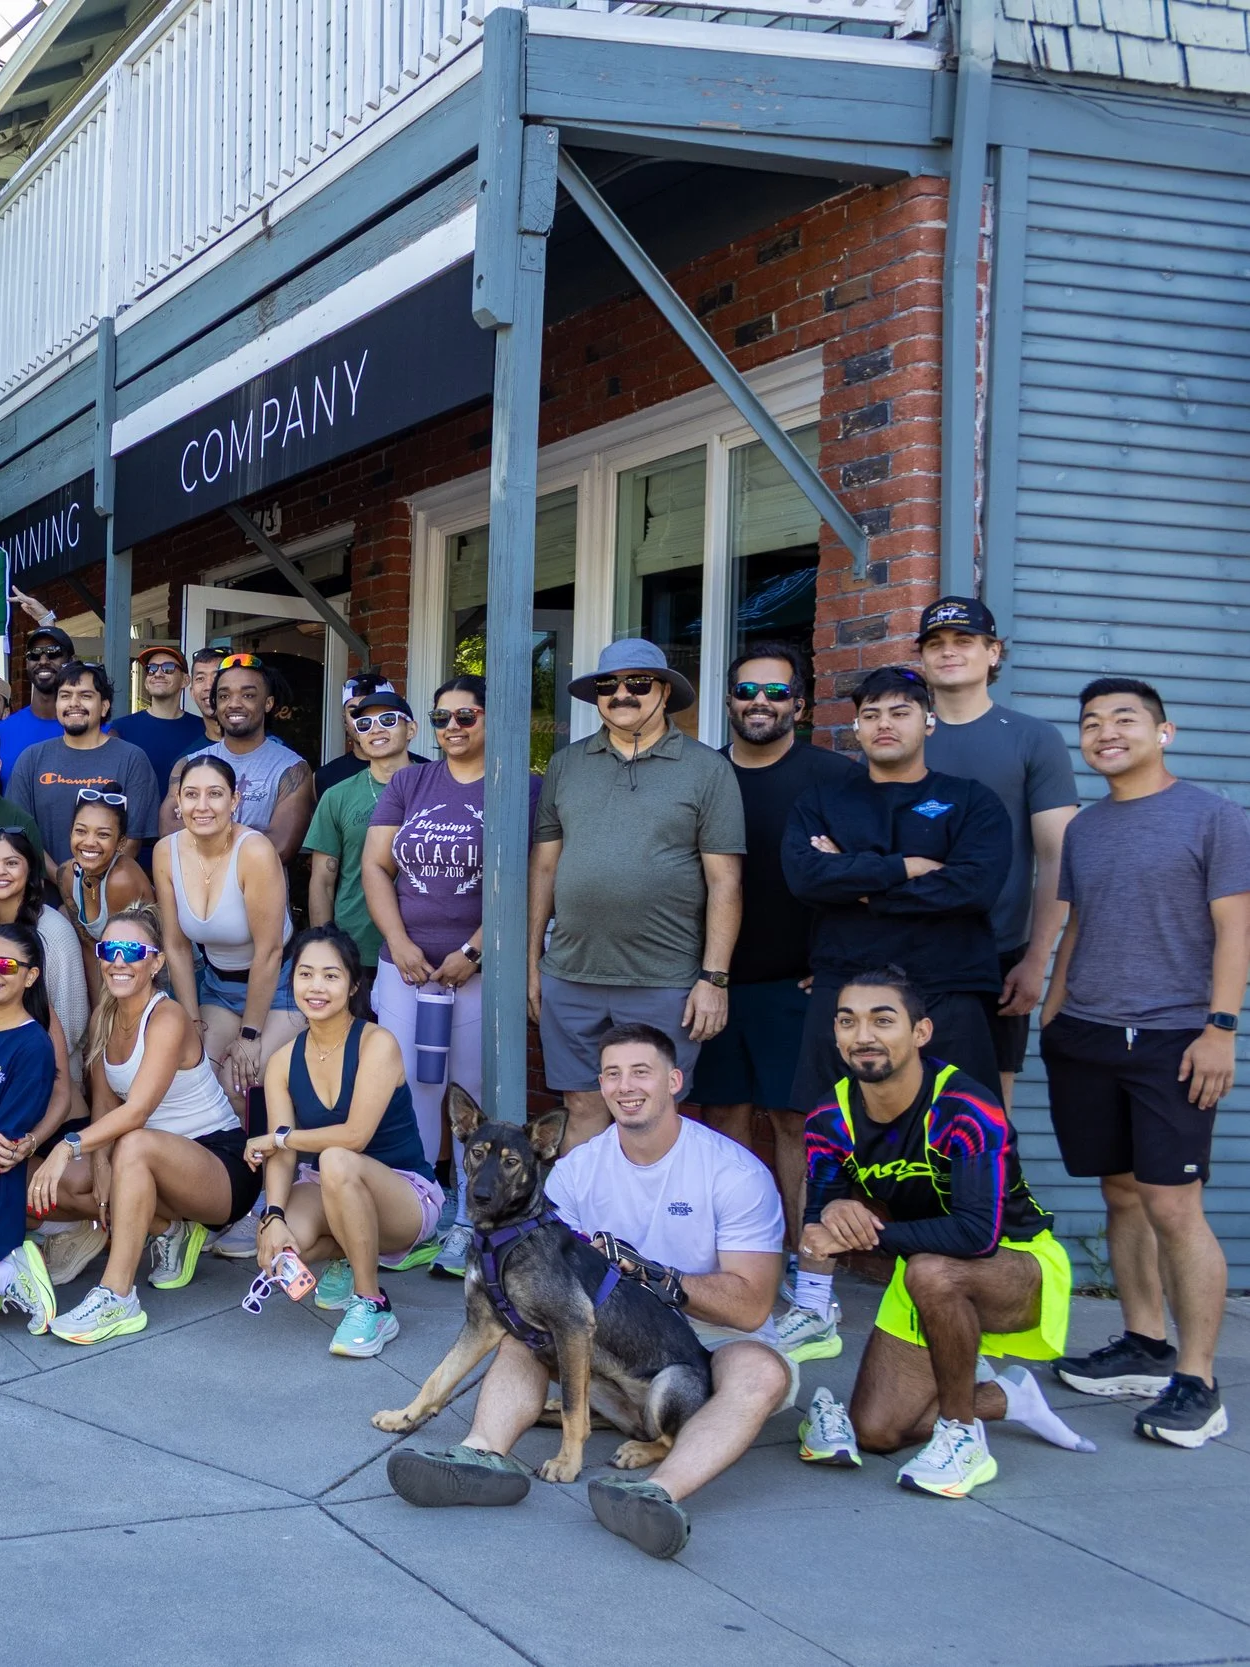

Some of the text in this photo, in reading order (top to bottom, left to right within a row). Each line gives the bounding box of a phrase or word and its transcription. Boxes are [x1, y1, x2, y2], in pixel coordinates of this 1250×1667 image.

[181, 349, 368, 492] COMPANY
[2, 502, 80, 575] UNNING
[415, 819, 474, 834] Blessings
[424, 830, 459, 844] from
[420, 865, 465, 878] 2017-2018
